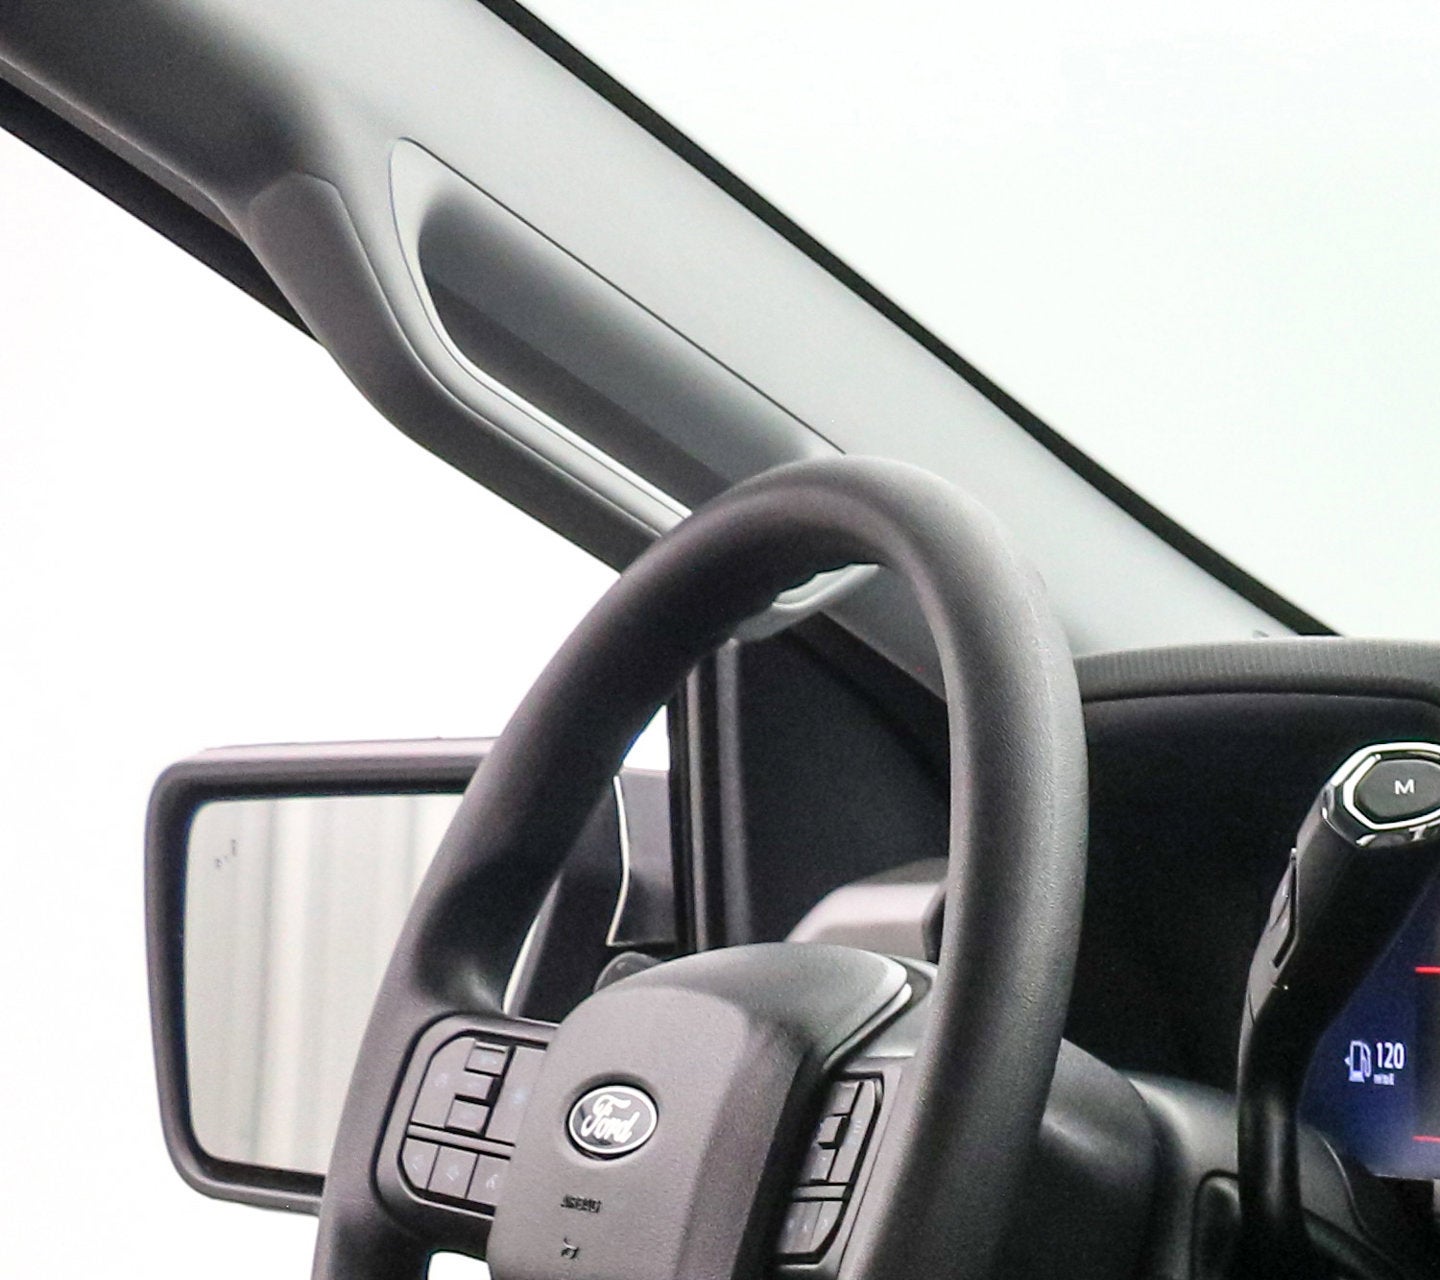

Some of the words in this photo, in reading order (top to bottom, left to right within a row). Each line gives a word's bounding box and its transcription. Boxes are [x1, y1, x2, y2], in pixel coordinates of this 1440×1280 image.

[1394, 778, 1415, 796] M
[1377, 1041, 1405, 1069] 120
[580, 1094, 640, 1143] Ford
